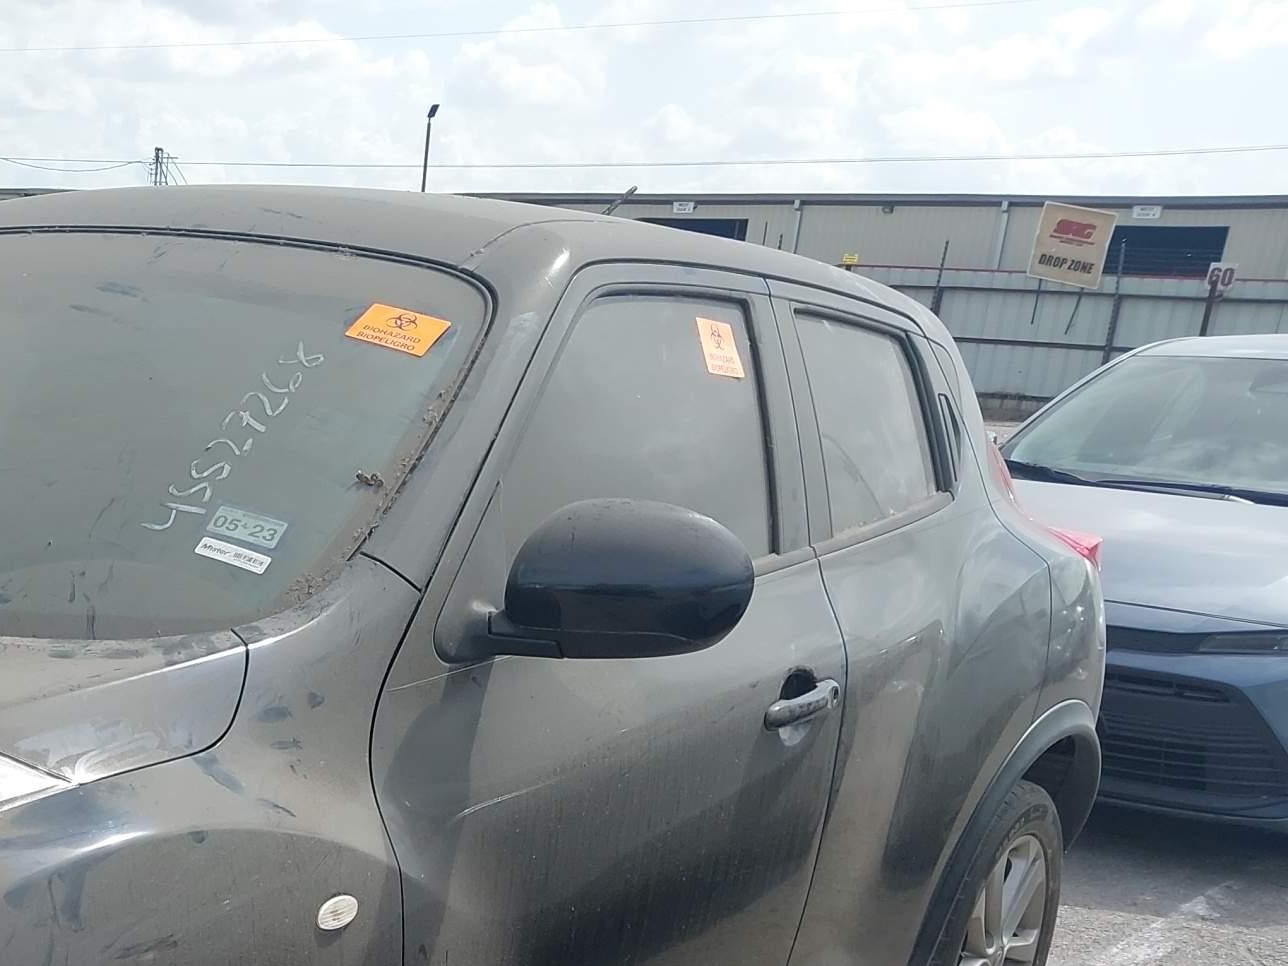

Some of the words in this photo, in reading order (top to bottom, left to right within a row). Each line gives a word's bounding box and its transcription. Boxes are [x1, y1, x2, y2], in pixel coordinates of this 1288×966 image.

[1038, 254, 1068, 269] DROP
[1067, 259, 1095, 274] ZONE
[1208, 267, 1235, 287] 60
[356, 331, 415, 351] BIOPELIGRO
[363, 324, 421, 344] BIOHAZARD
